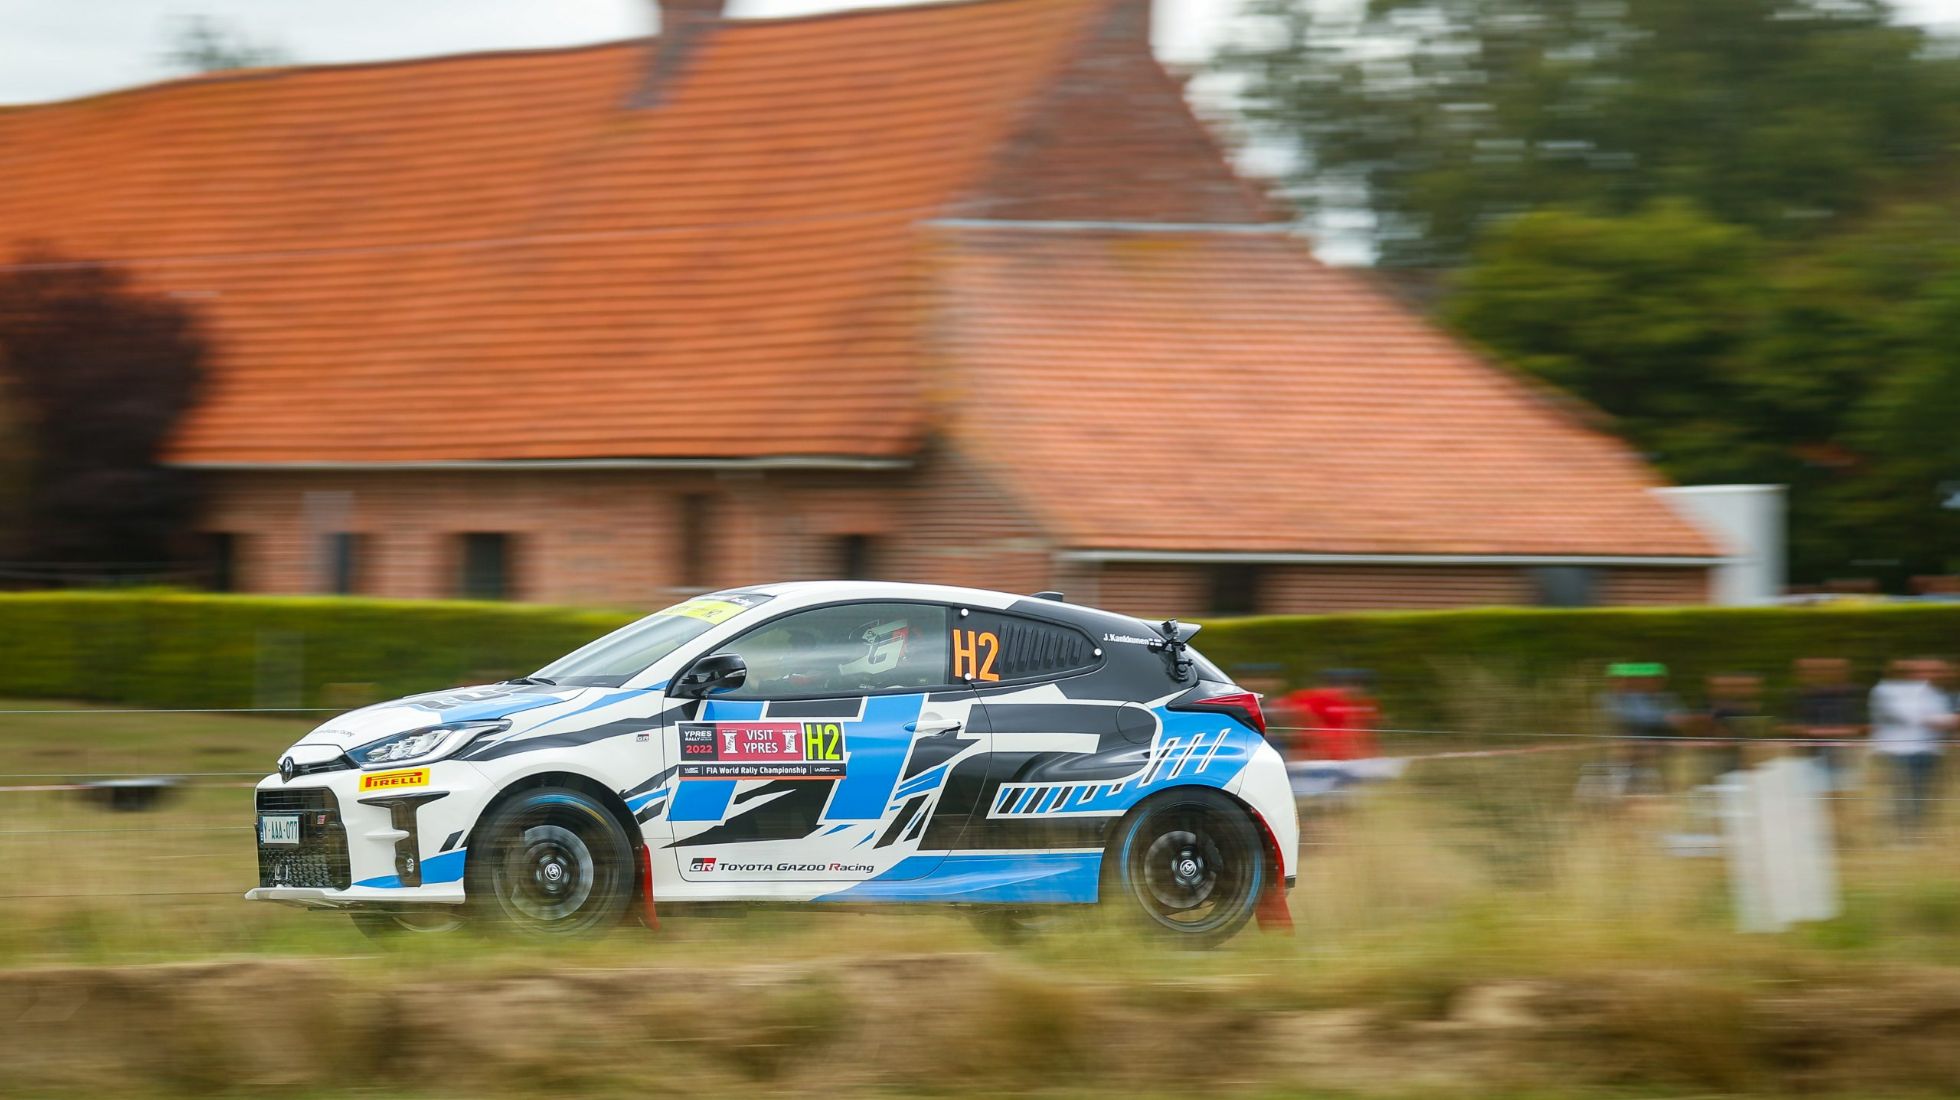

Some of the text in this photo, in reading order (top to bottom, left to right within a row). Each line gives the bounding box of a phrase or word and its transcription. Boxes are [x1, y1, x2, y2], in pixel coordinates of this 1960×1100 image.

[953, 629, 999, 682] H2
[746, 729, 774, 741] VISIT
[805, 723, 840, 760] H2
[686, 745, 712, 754] 2022
[743, 742, 778, 754] YPRES
[741, 767, 758, 775] Rally
[760, 766, 807, 775] Championship
[365, 771, 422, 788] PIRELLI
[690, 861, 875, 873] GR TOYOTA GAZOO Racing
